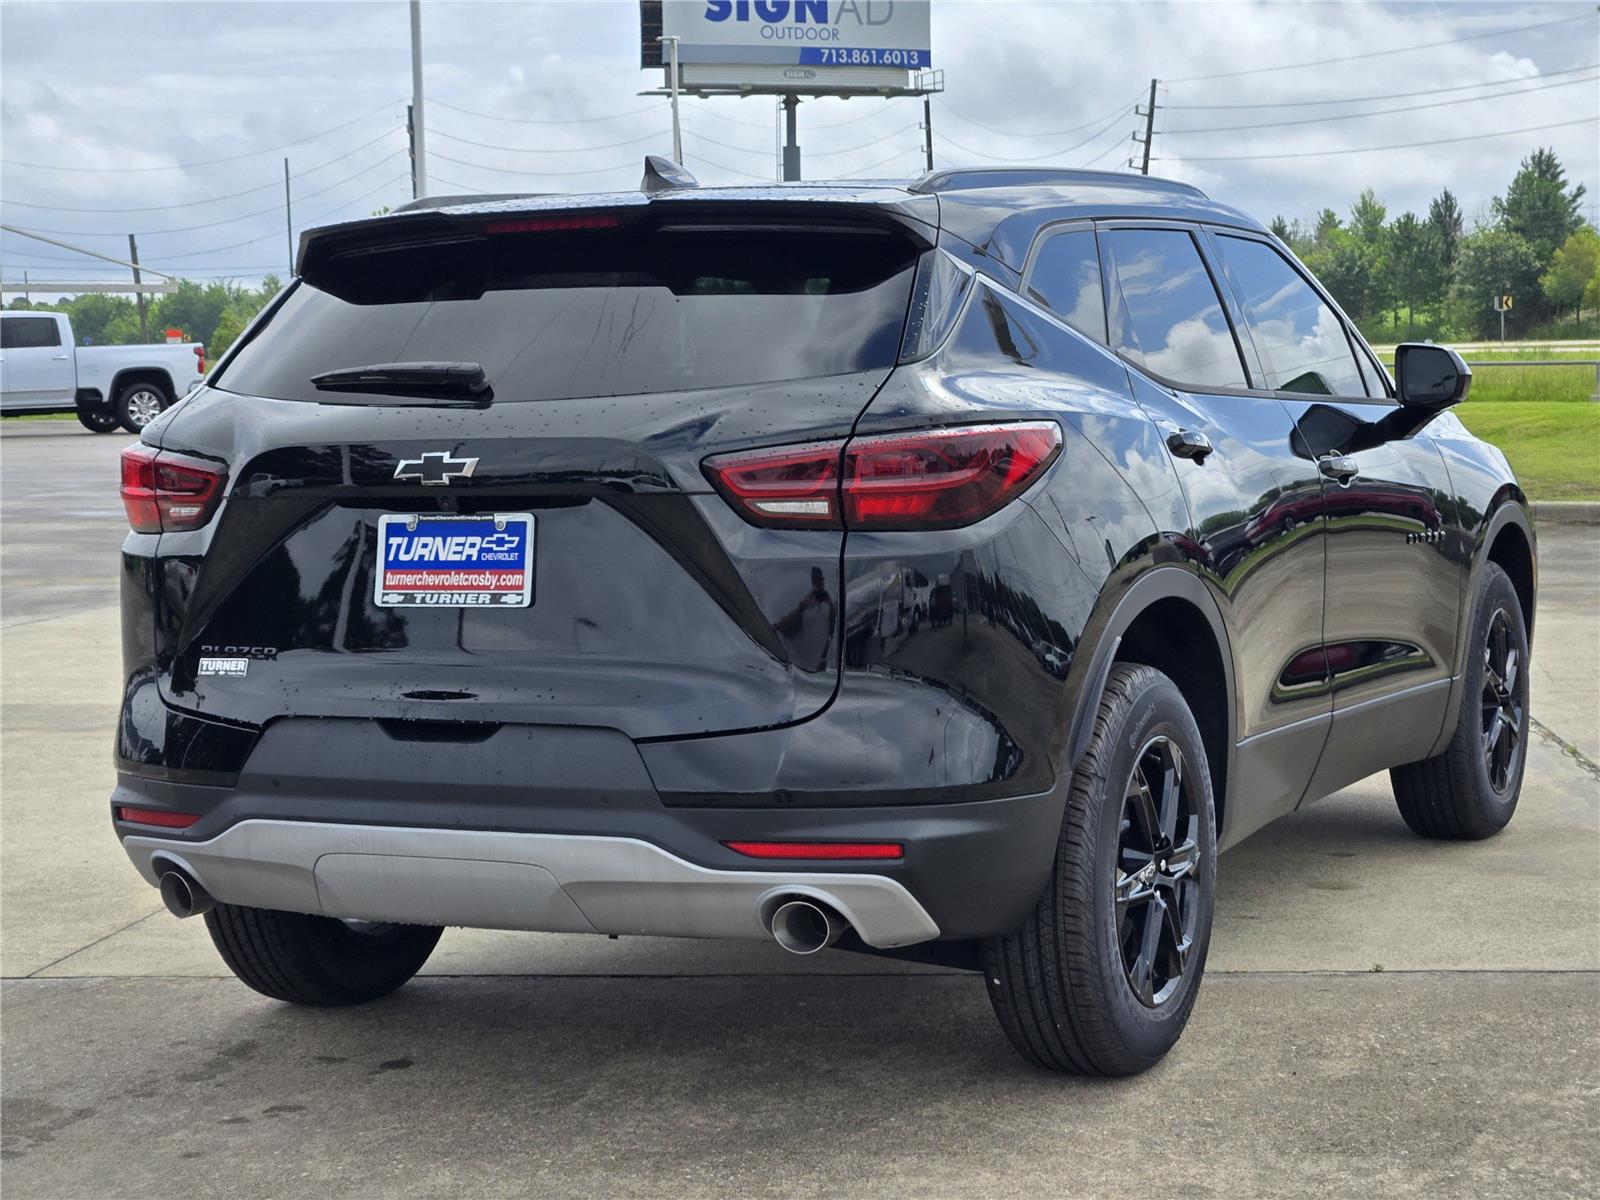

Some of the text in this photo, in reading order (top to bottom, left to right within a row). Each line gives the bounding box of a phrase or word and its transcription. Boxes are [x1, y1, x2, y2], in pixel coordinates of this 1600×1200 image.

[833, 0, 894, 26] AD
[760, 25, 840, 41] OUTDOOR
[820, 48, 919, 65] 713.861.6013
[388, 536, 482, 562] TURNER
[481, 552, 520, 561] CHEVROLET
[385, 571, 523, 589] turnerchevroletcrosby.com
[413, 593, 492, 604] TURNER
[202, 660, 246, 671] TURNER
